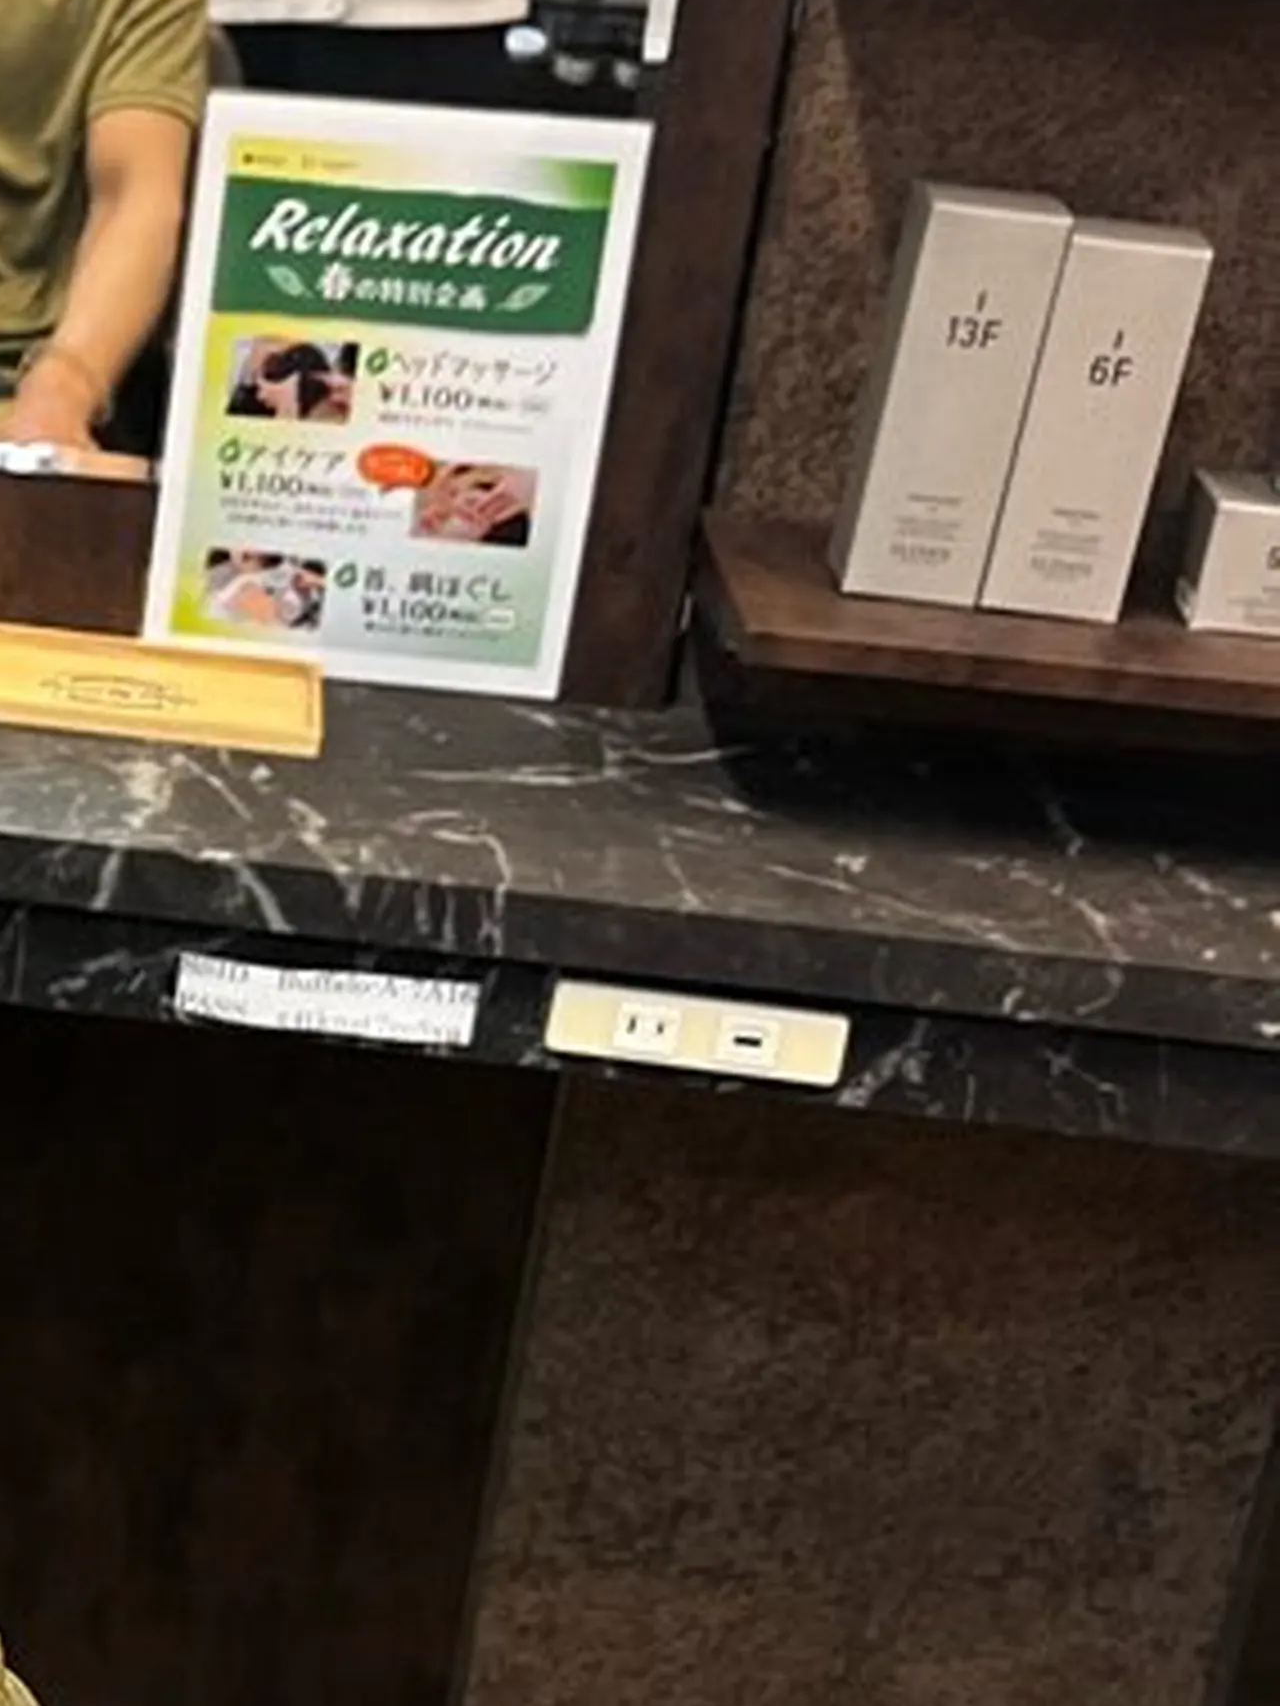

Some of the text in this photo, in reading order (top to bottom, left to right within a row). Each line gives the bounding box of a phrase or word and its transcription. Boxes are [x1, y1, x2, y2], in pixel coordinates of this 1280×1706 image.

[249, 197, 561, 272] Relaxation
[945, 315, 1004, 349] 13F
[1089, 354, 1134, 387] 6F
